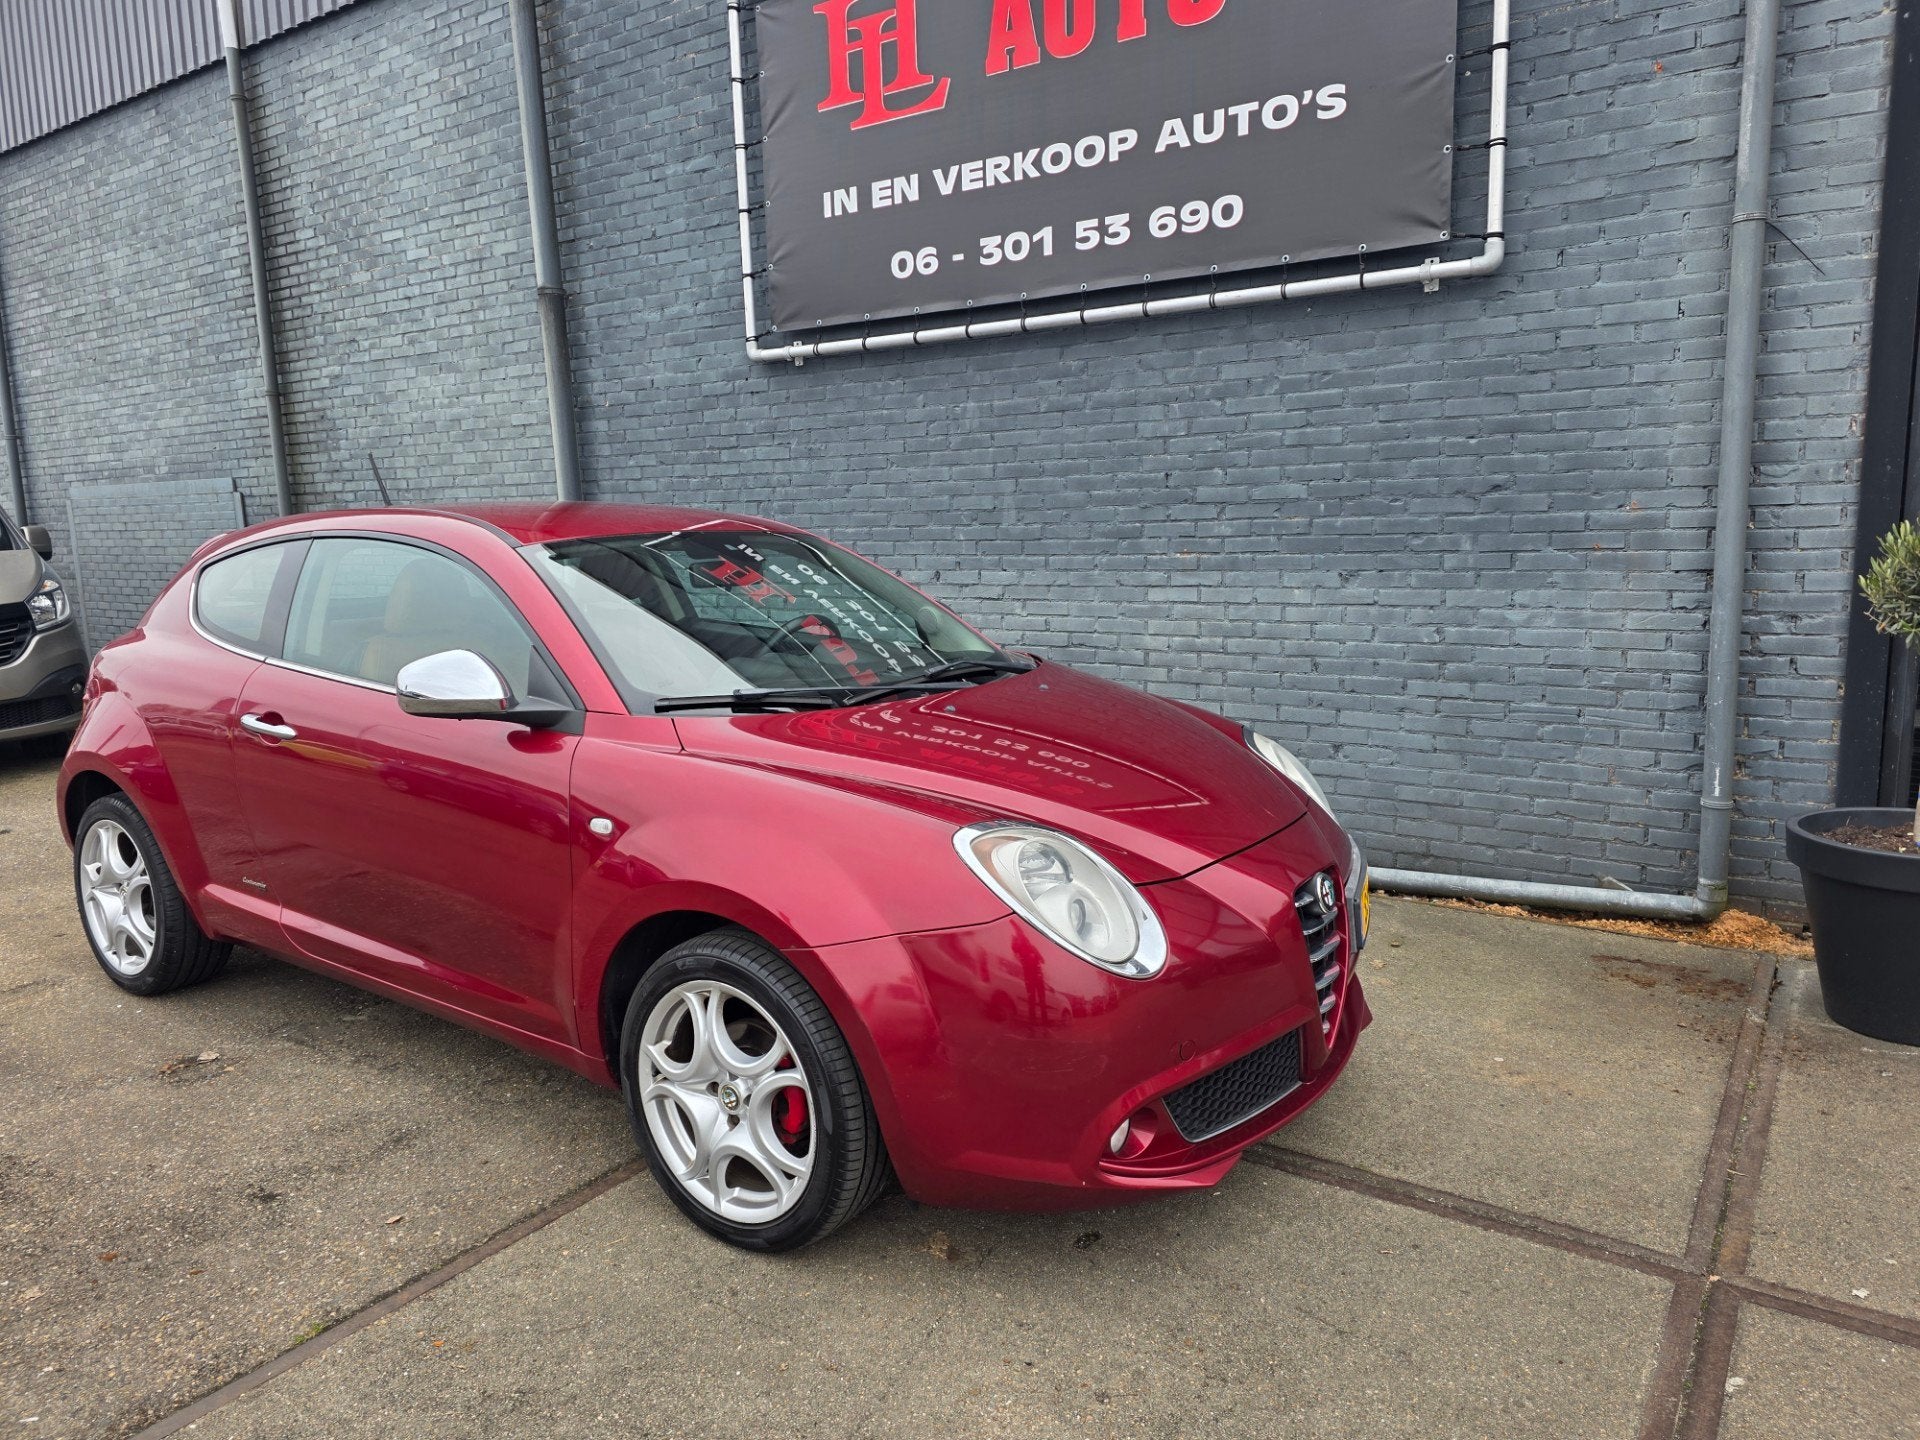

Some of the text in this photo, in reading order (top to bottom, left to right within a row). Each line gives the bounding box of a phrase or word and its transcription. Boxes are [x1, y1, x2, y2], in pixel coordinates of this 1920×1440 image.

[823, 83, 1347, 218] IN EN VERKOOP AUTO'S
[890, 194, 1244, 279] 06 - 301 53 690
